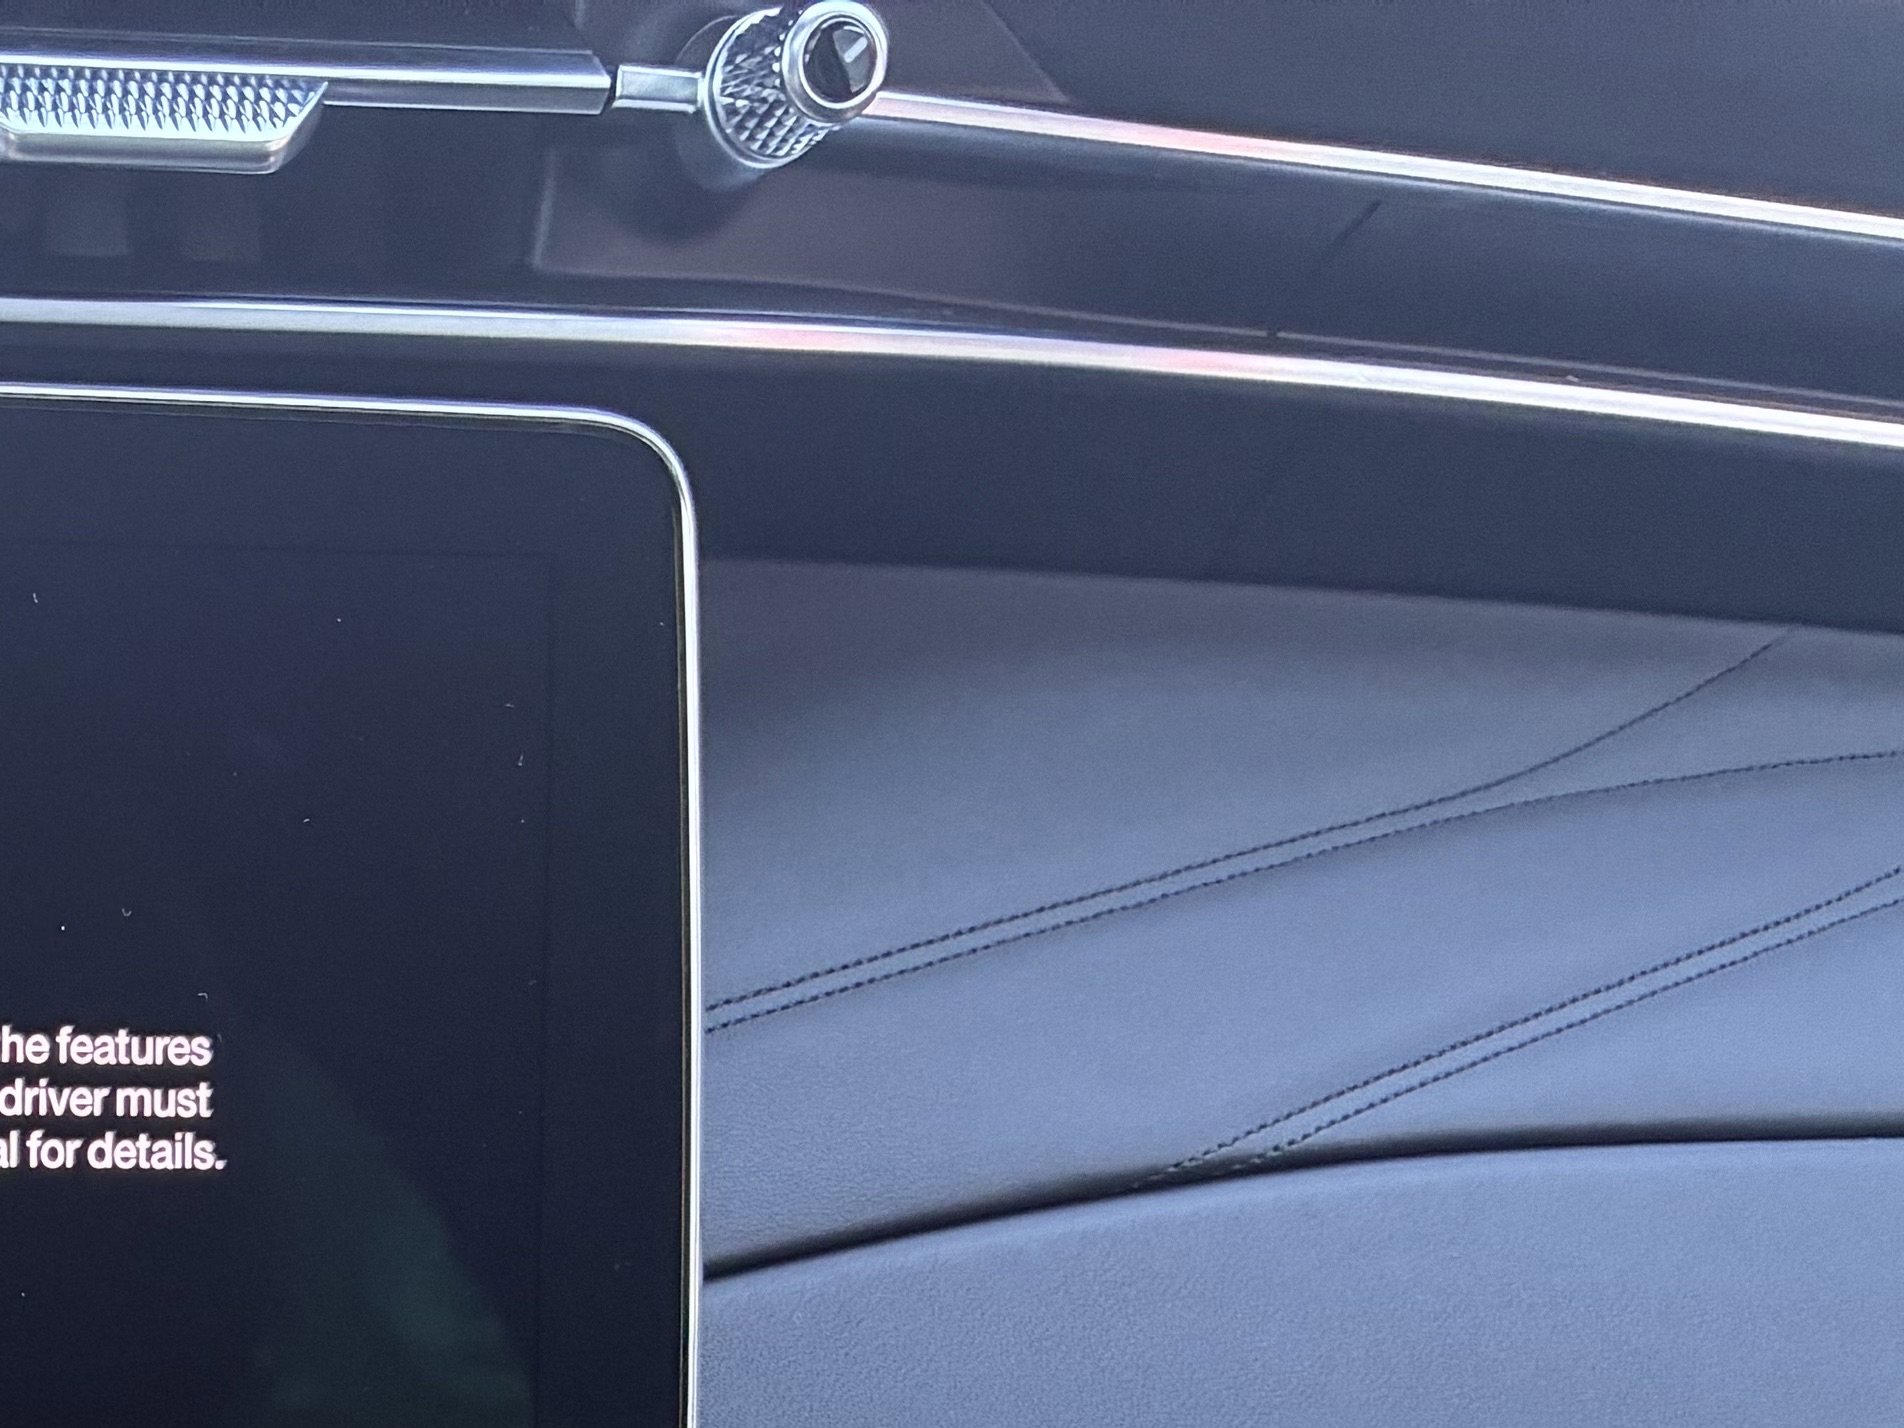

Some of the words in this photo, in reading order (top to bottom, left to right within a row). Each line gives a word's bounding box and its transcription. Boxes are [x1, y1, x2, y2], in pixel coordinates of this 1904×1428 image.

[55, 1025, 214, 1067] features
[115, 1080, 214, 1119] must
[25, 1129, 84, 1170] for
[86, 1130, 228, 1171] details.
